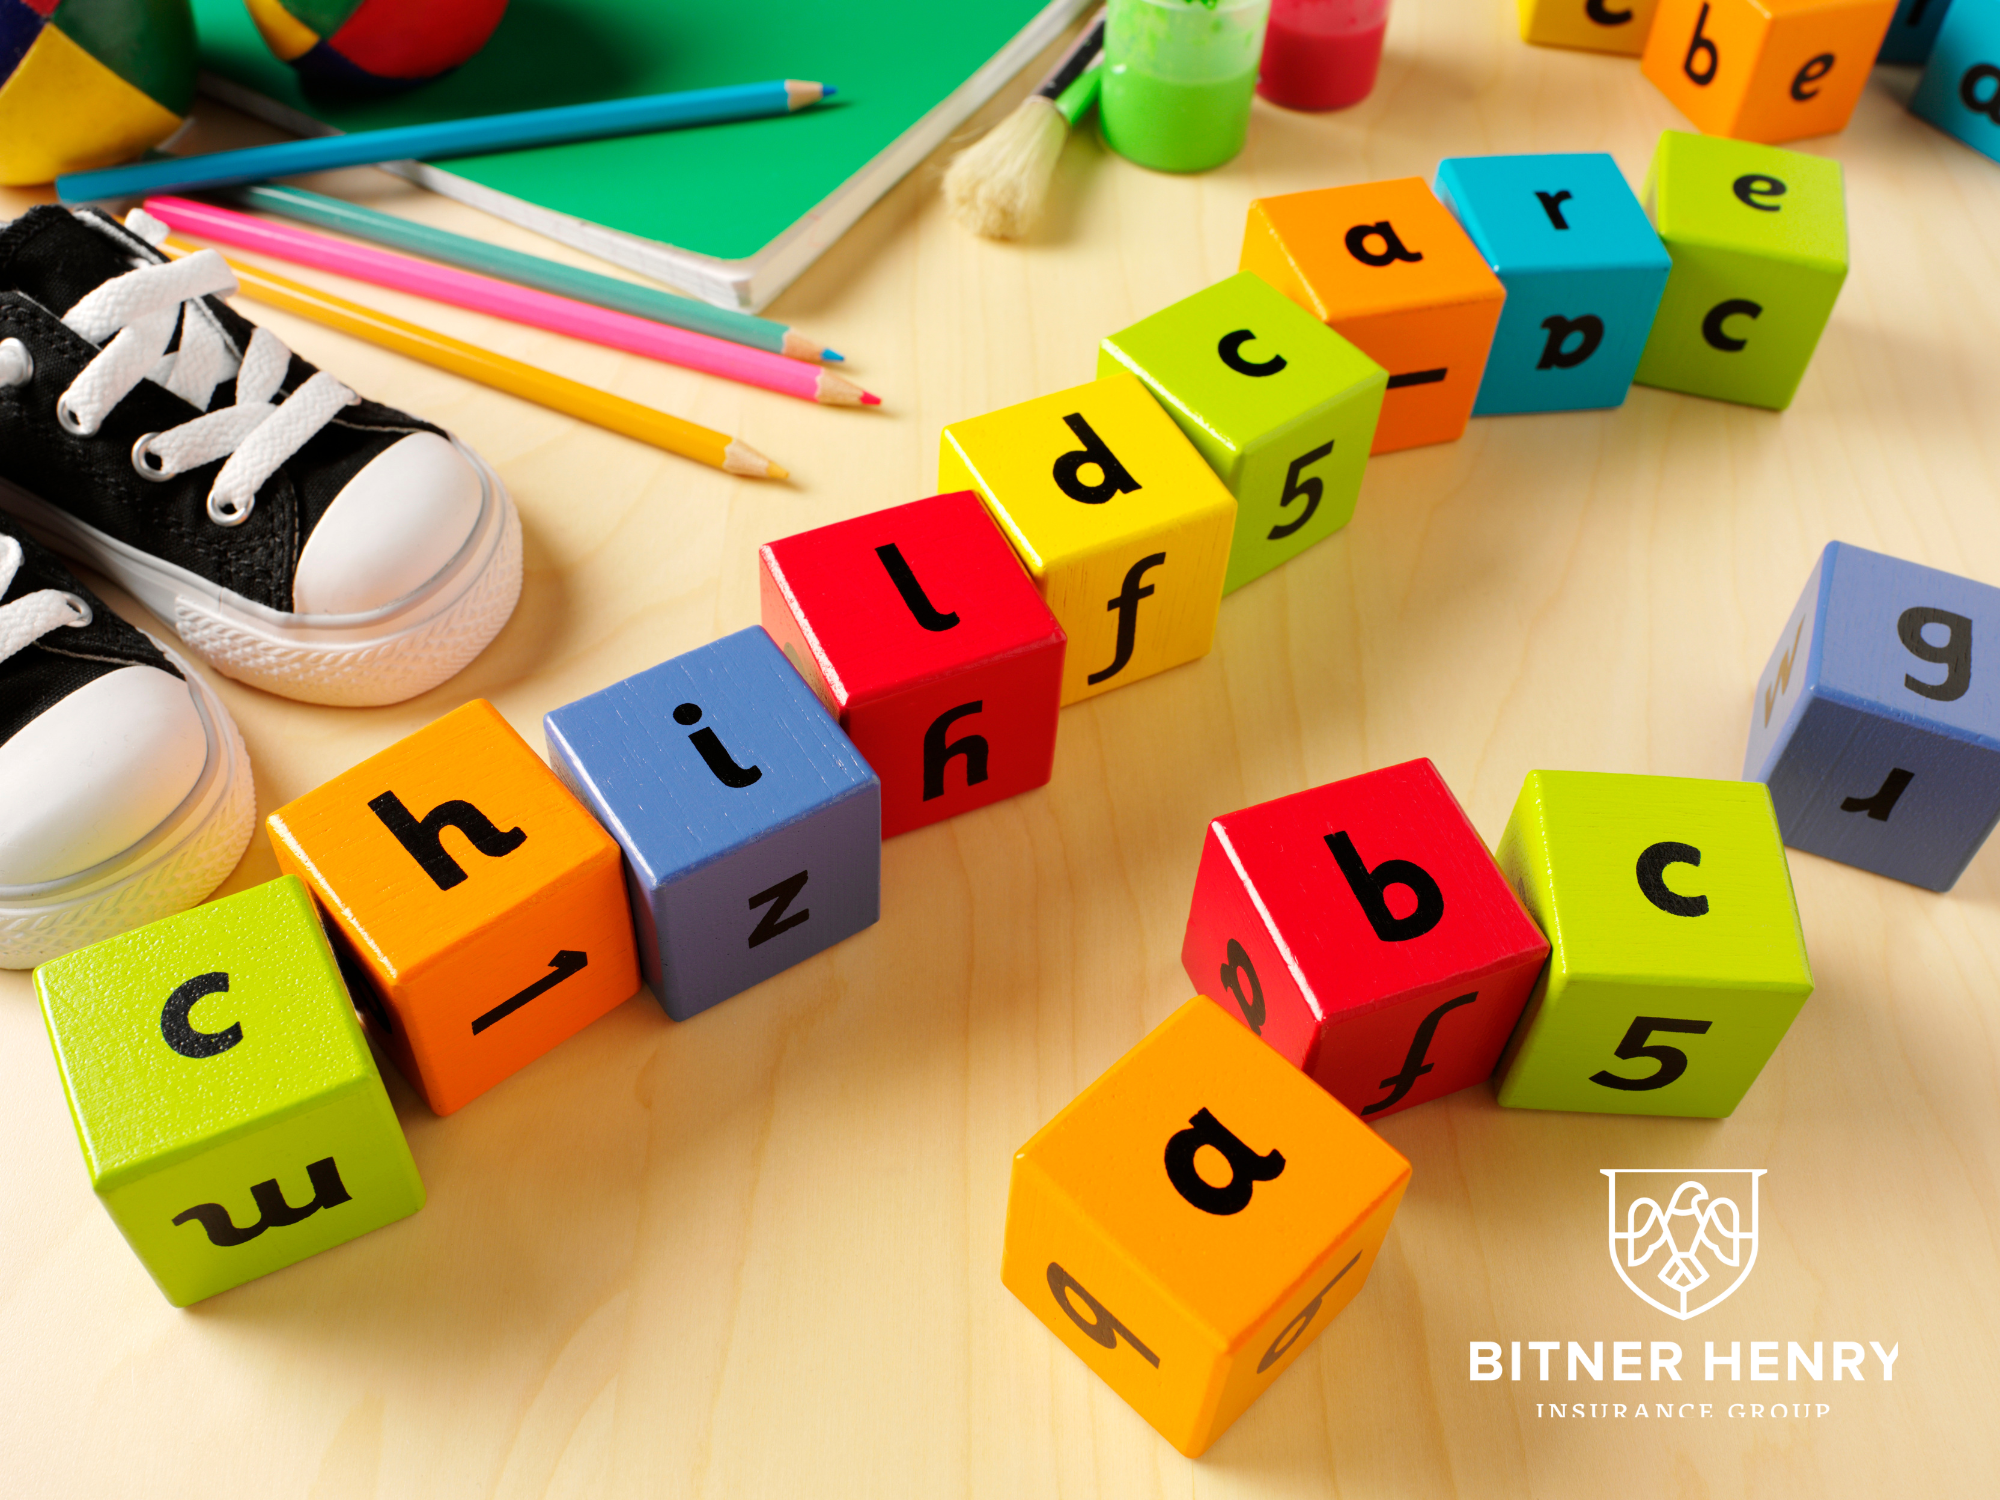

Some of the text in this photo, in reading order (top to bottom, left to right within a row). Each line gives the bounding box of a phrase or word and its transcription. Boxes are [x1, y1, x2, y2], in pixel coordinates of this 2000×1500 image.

[1685, 3, 1717, 85] b
[1791, 54, 1834, 101] e
[1535, 191, 1571, 230] r
[1733, 175, 1786, 211] e
[1346, 222, 1422, 266] a
[1218, 330, 1287, 377] c
[1701, 299, 1762, 352] c
[1053, 413, 1142, 504] d
[1268, 441, 1334, 540] 5
[1088, 552, 1165, 685] f
[673, 703, 762, 788] i
[368, 791, 526, 890] h
[1636, 842, 1709, 917] c
[1324, 831, 1444, 942] b
[161, 972, 243, 1058] c
[1361, 992, 1478, 1115] f
[1589, 1016, 1712, 1091] 5
[1165, 1108, 1285, 1215] a
